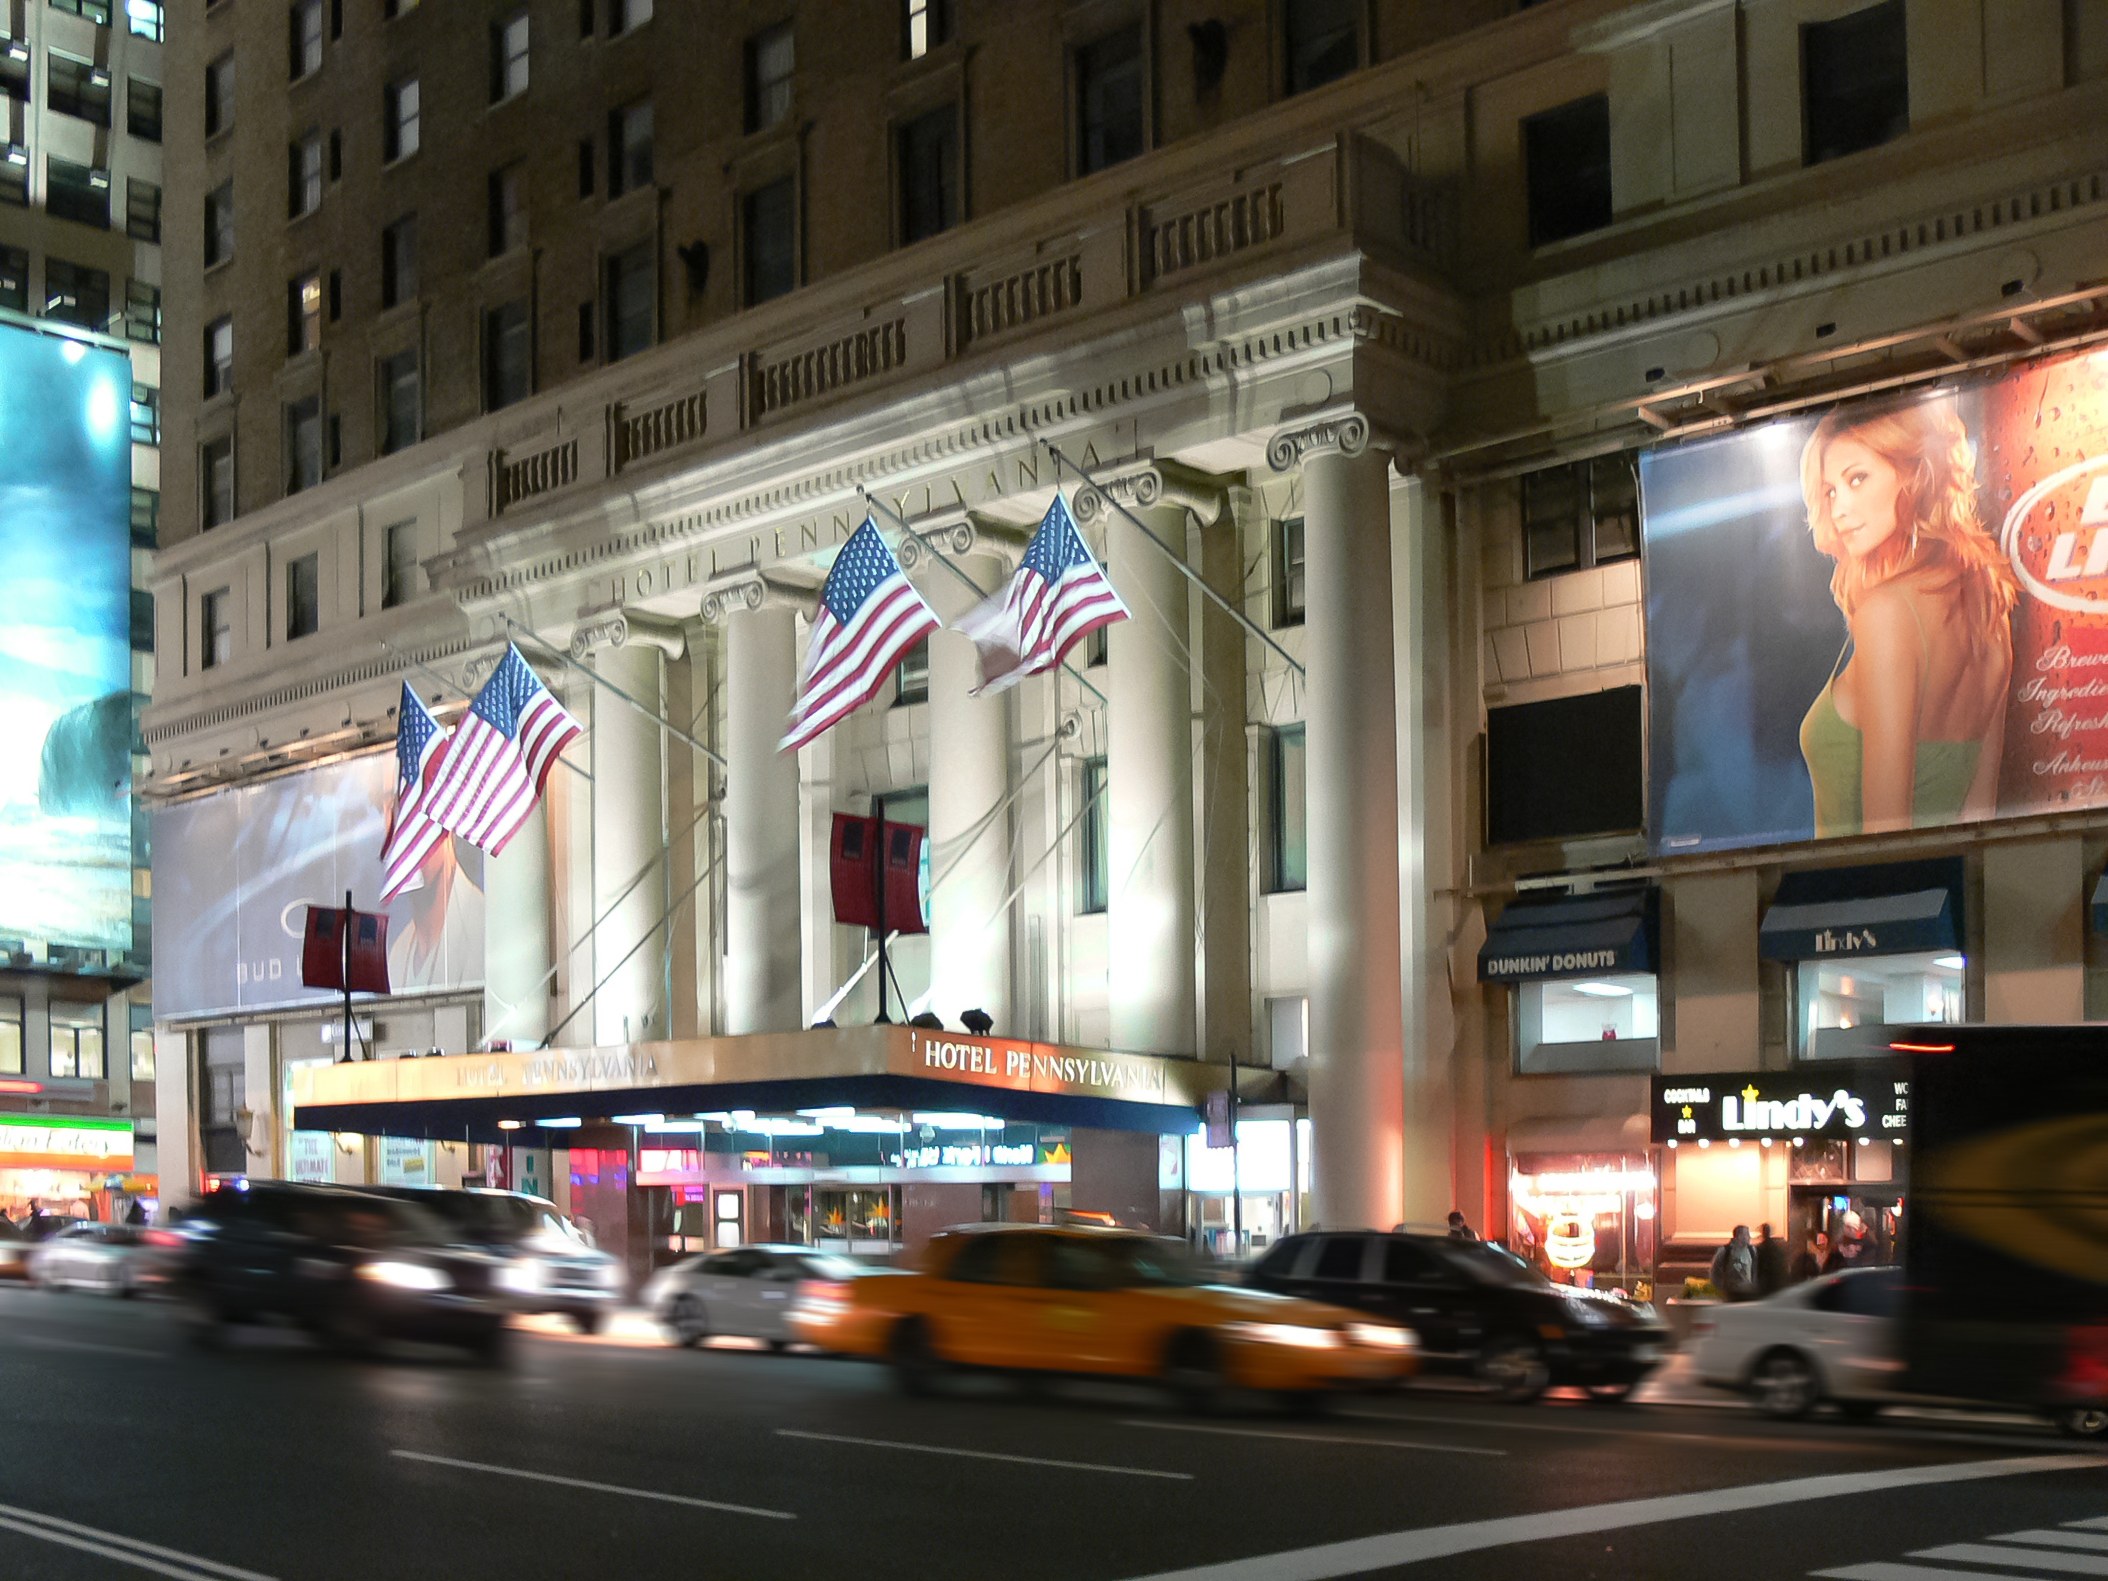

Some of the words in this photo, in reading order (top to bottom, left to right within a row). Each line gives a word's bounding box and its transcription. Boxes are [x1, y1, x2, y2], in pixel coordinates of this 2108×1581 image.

[611, 546, 719, 605] HOTEL
[750, 439, 1102, 566] PENNYLVANIA
[1488, 956, 1550, 976] DUNKIN'
[1553, 950, 1616, 971] DONUTS
[521, 1055, 658, 1086] PENNSYLVANIA
[925, 1040, 998, 1075] HOTEL
[1006, 1050, 1163, 1092] PENNSYLVANIA
[1722, 1085, 1867, 1131] Lindy's
